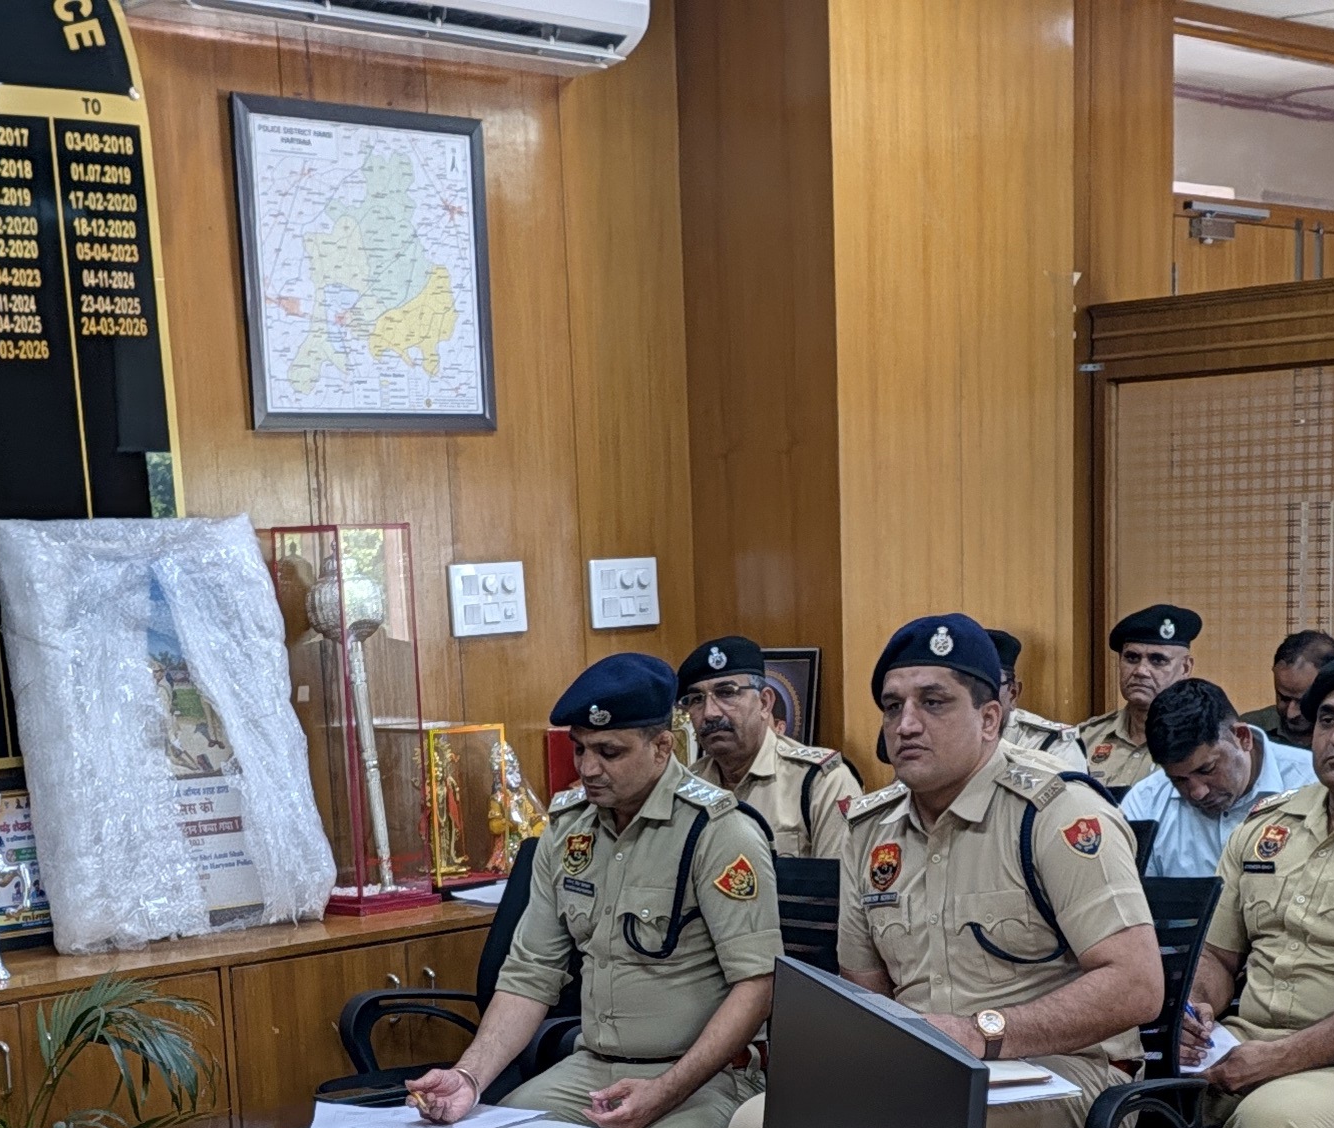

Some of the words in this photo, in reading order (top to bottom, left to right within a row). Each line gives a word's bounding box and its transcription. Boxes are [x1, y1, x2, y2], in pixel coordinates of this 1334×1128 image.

[82, 97, 101, 116] TO
[64, 130, 134, 156] 03-08-2018
[70, 162, 132, 186] 01.07.2019
[68, 190, 138, 213] 17-02-2020
[72, 216, 137, 239] 18-12-2020
[75, 241, 140, 263] 05-04-2023
[82, 268, 136, 290] 04-11-2024
[80, 293, 142, 316] 23-04-2025
[80, 316, 149, 337] 24-03-2026
